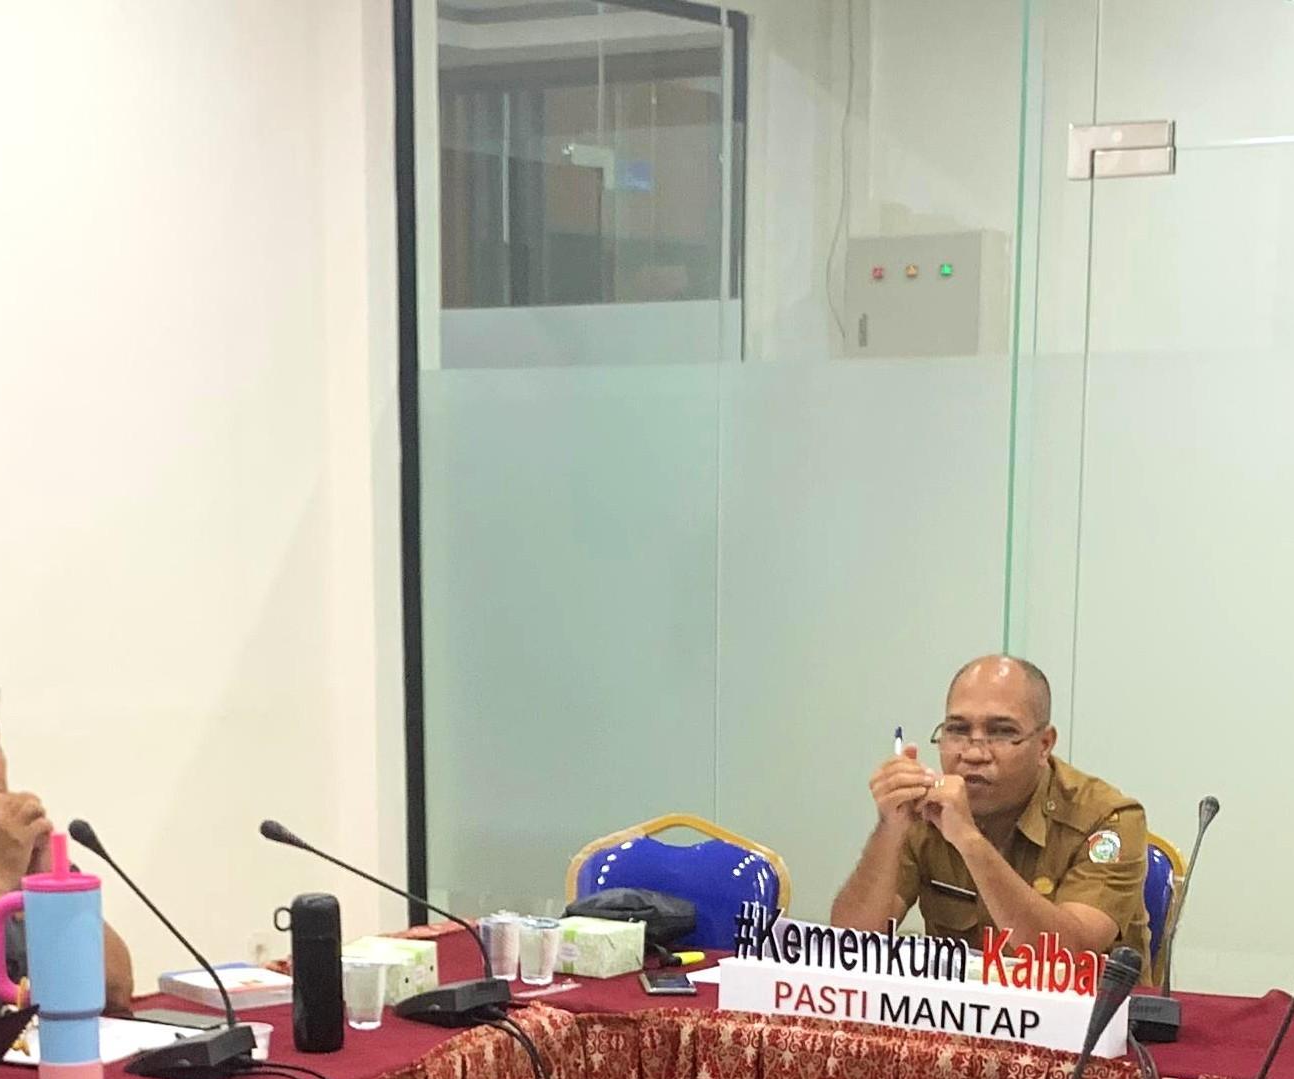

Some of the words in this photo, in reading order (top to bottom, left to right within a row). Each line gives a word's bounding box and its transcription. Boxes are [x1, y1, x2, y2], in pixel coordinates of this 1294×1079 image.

[734, 901, 968, 981] #Kemenkum
[775, 981, 867, 1019] PASTI
[880, 993, 1039, 1039] MANTAP
